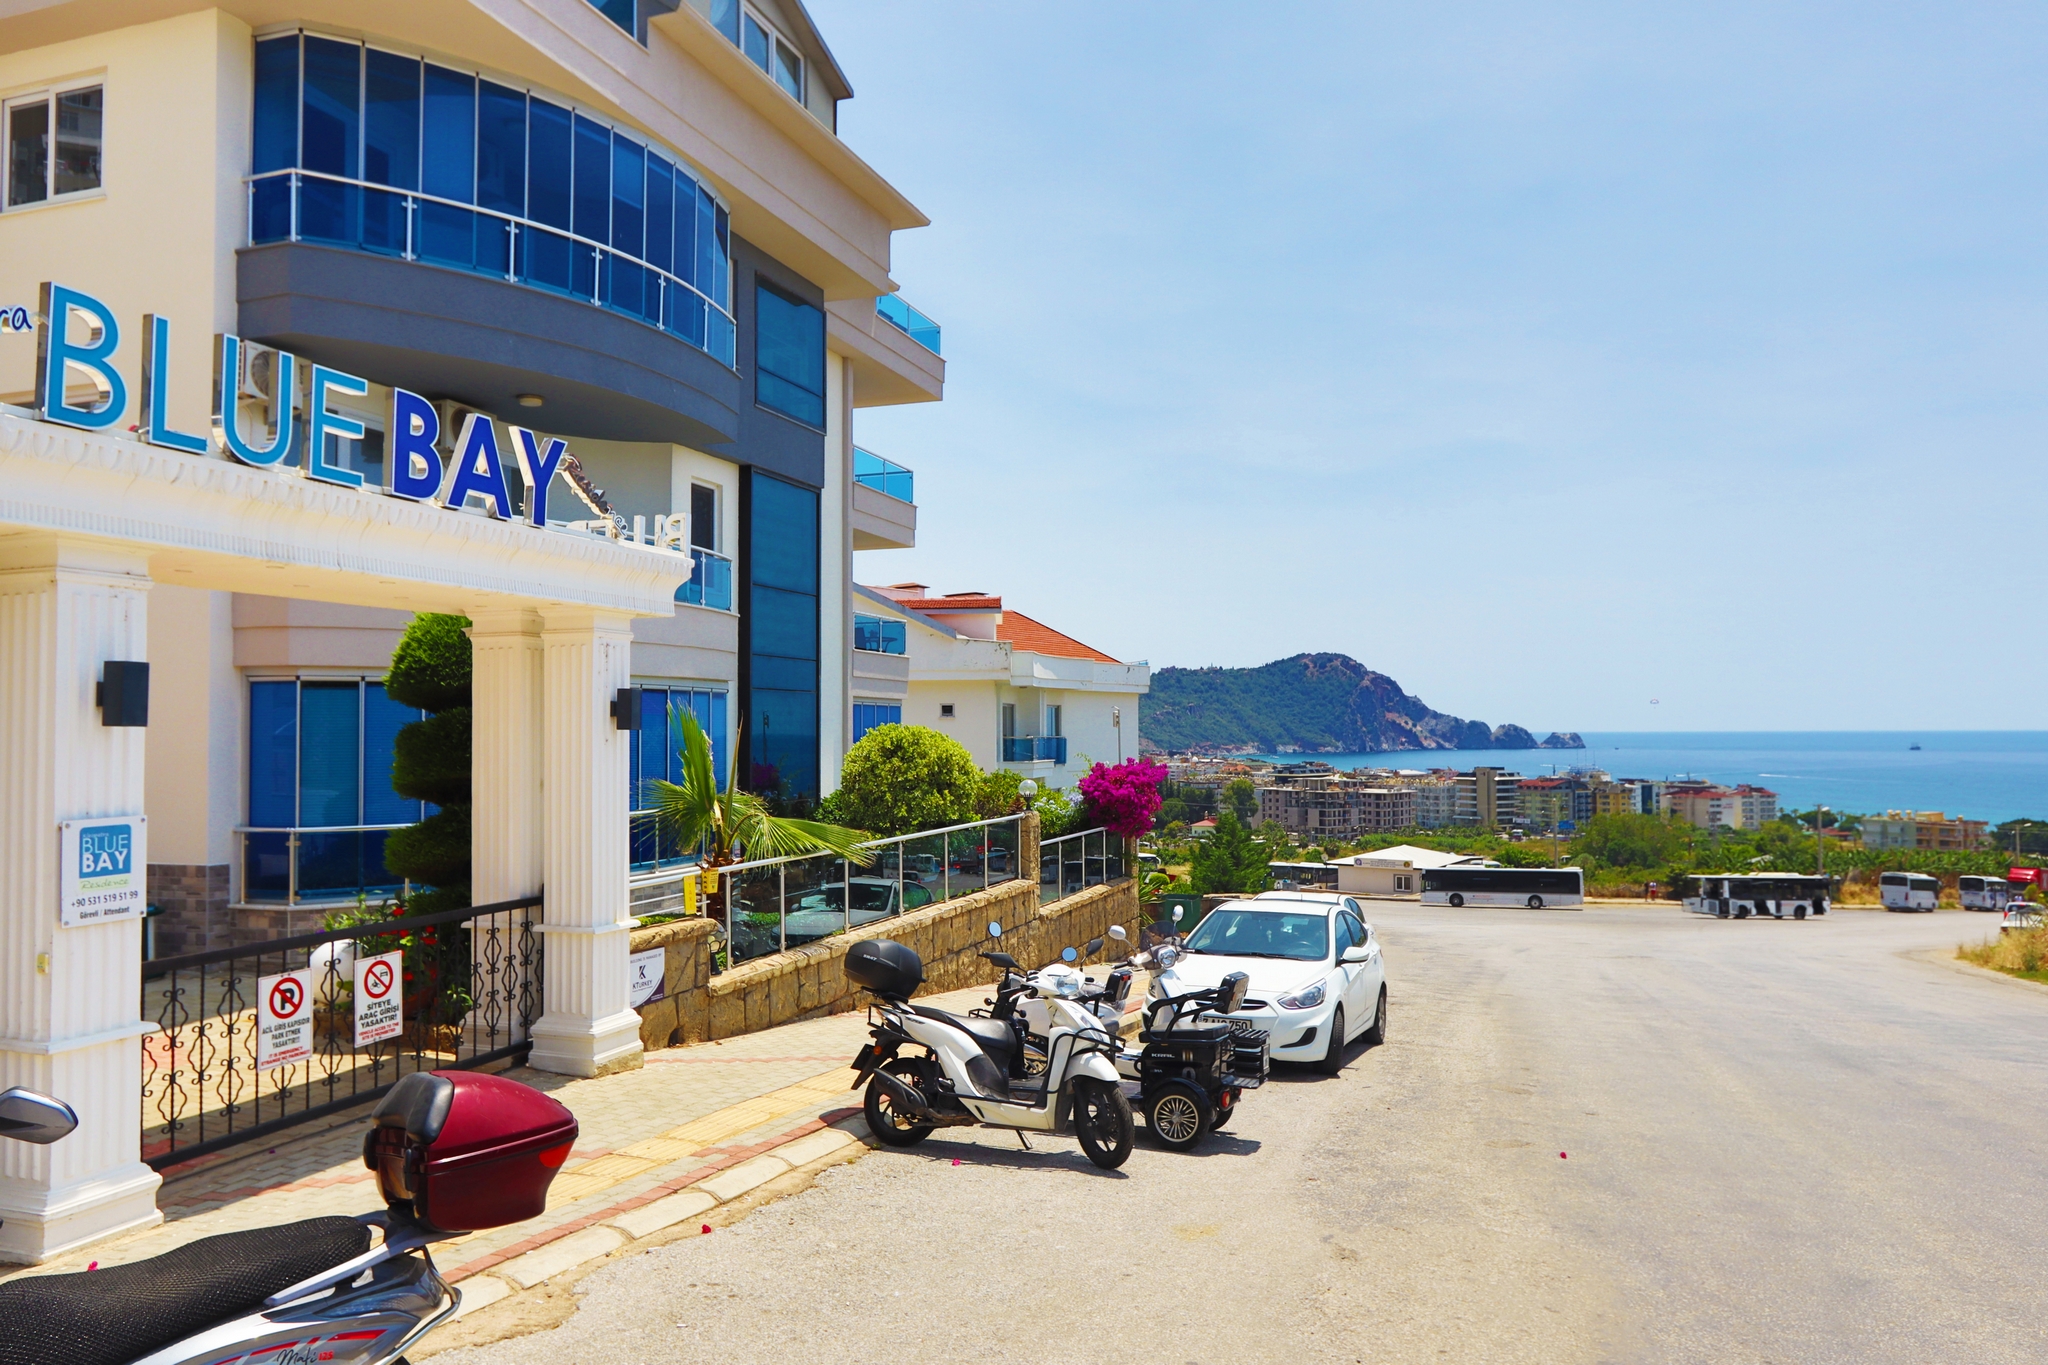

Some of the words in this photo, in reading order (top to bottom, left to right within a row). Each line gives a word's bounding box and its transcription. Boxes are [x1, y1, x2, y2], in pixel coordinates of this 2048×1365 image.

[44, 281, 368, 488] BLUE
[391, 386, 568, 527] BAY
[82, 834, 128, 854] BLUE
[82, 850, 128, 873] BAY
[80, 879, 129, 890] Residence
[71, 898, 85, 907] +90
[88, 896, 100, 906] 531
[103, 893, 117, 903] 519
[119, 892, 127, 901] 51
[129, 890, 138, 899] 99
[358, 1011, 378, 1021] ARAÇ
[379, 1003, 399, 1016] GİRİŞİ
[367, 998, 391, 1011] SİTEYE
[1229, 1020, 1248, 1030] 750
[318, 1350, 334, 1361] 125
